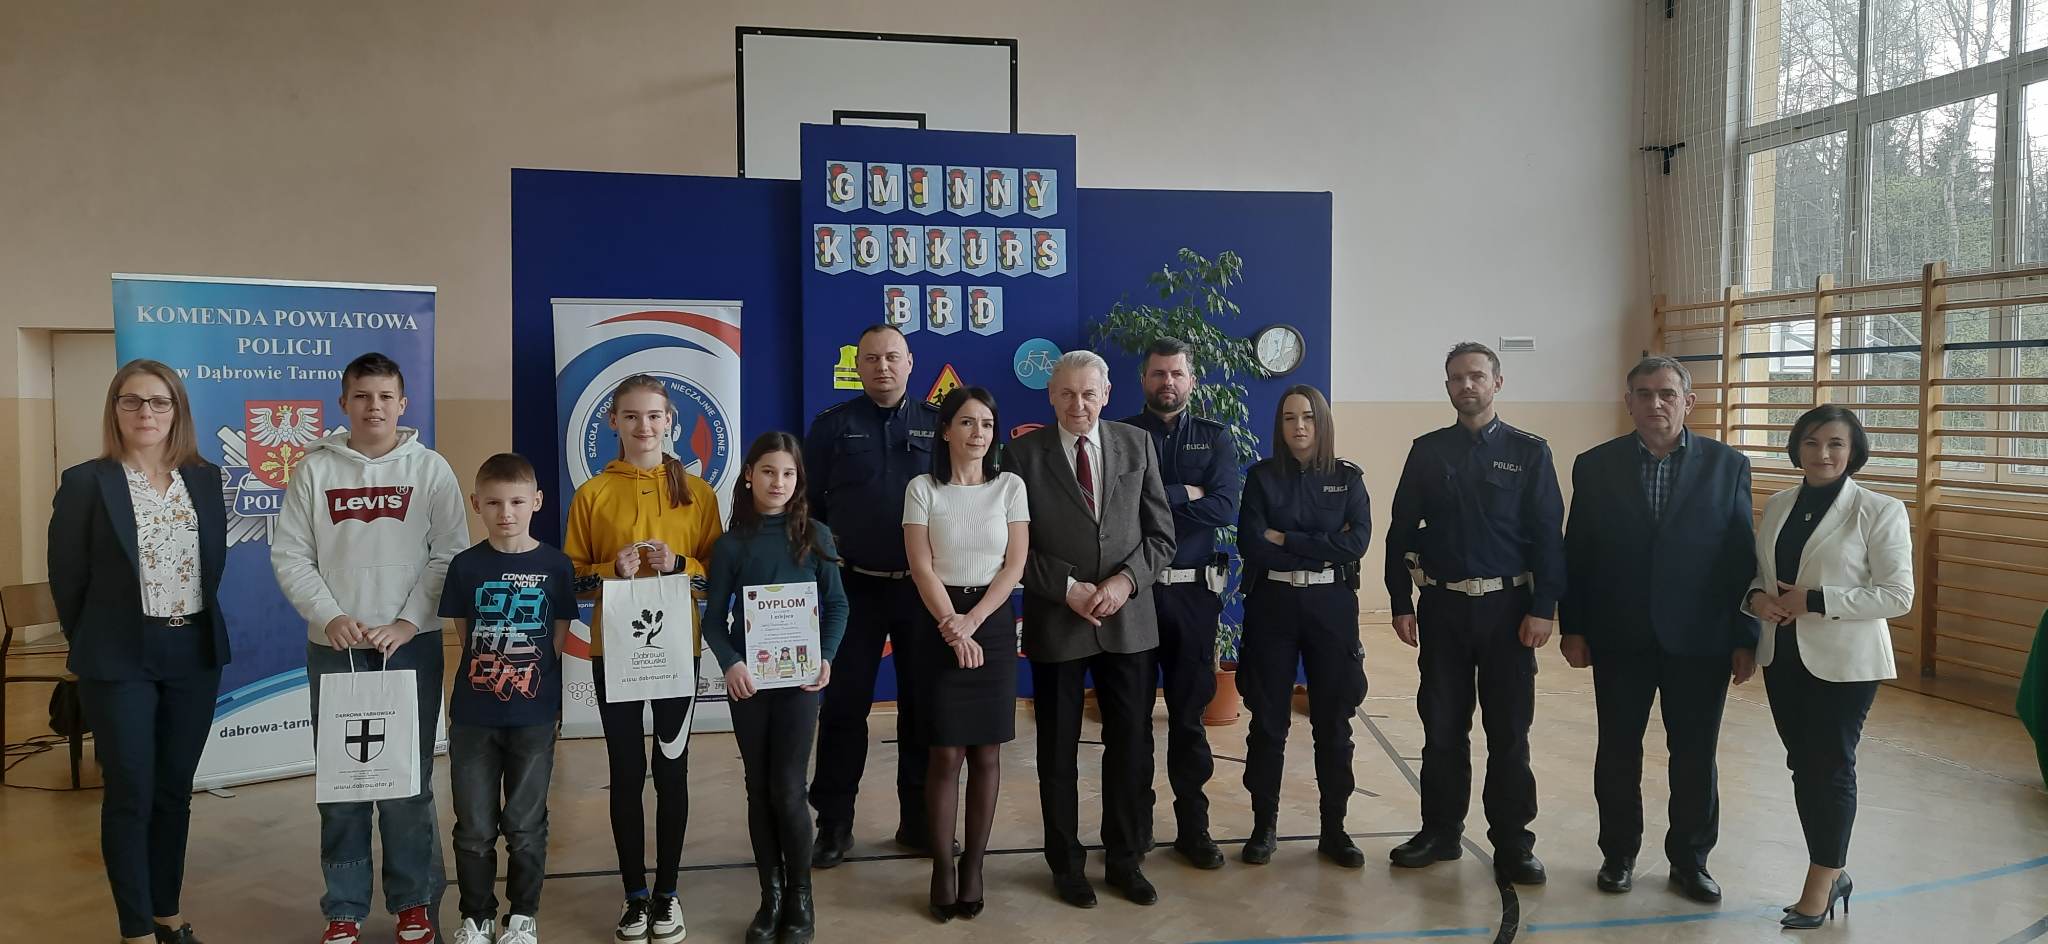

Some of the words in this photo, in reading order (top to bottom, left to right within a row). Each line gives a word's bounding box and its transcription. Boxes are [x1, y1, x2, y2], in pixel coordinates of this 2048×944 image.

[836, 172, 1049, 207] GMINNY
[823, 235, 1059, 266] KONKURS
[136, 305, 268, 327] KOMENDA
[275, 309, 418, 331] POWIATOWA
[893, 296, 995, 325] BRD
[237, 338, 333, 357] POLICJI
[197, 365, 282, 382] Dąbrowie
[588, 422, 600, 459] SZKOŁA
[670, 381, 716, 417] NIECZAJNIE
[713, 419, 726, 457] GÓRNEJ
[243, 494, 282, 511] POL
[502, 573, 548, 582] CONNECT
[758, 598, 806, 610] DYPLOM
[220, 719, 311, 738] dabrowa-tarn
